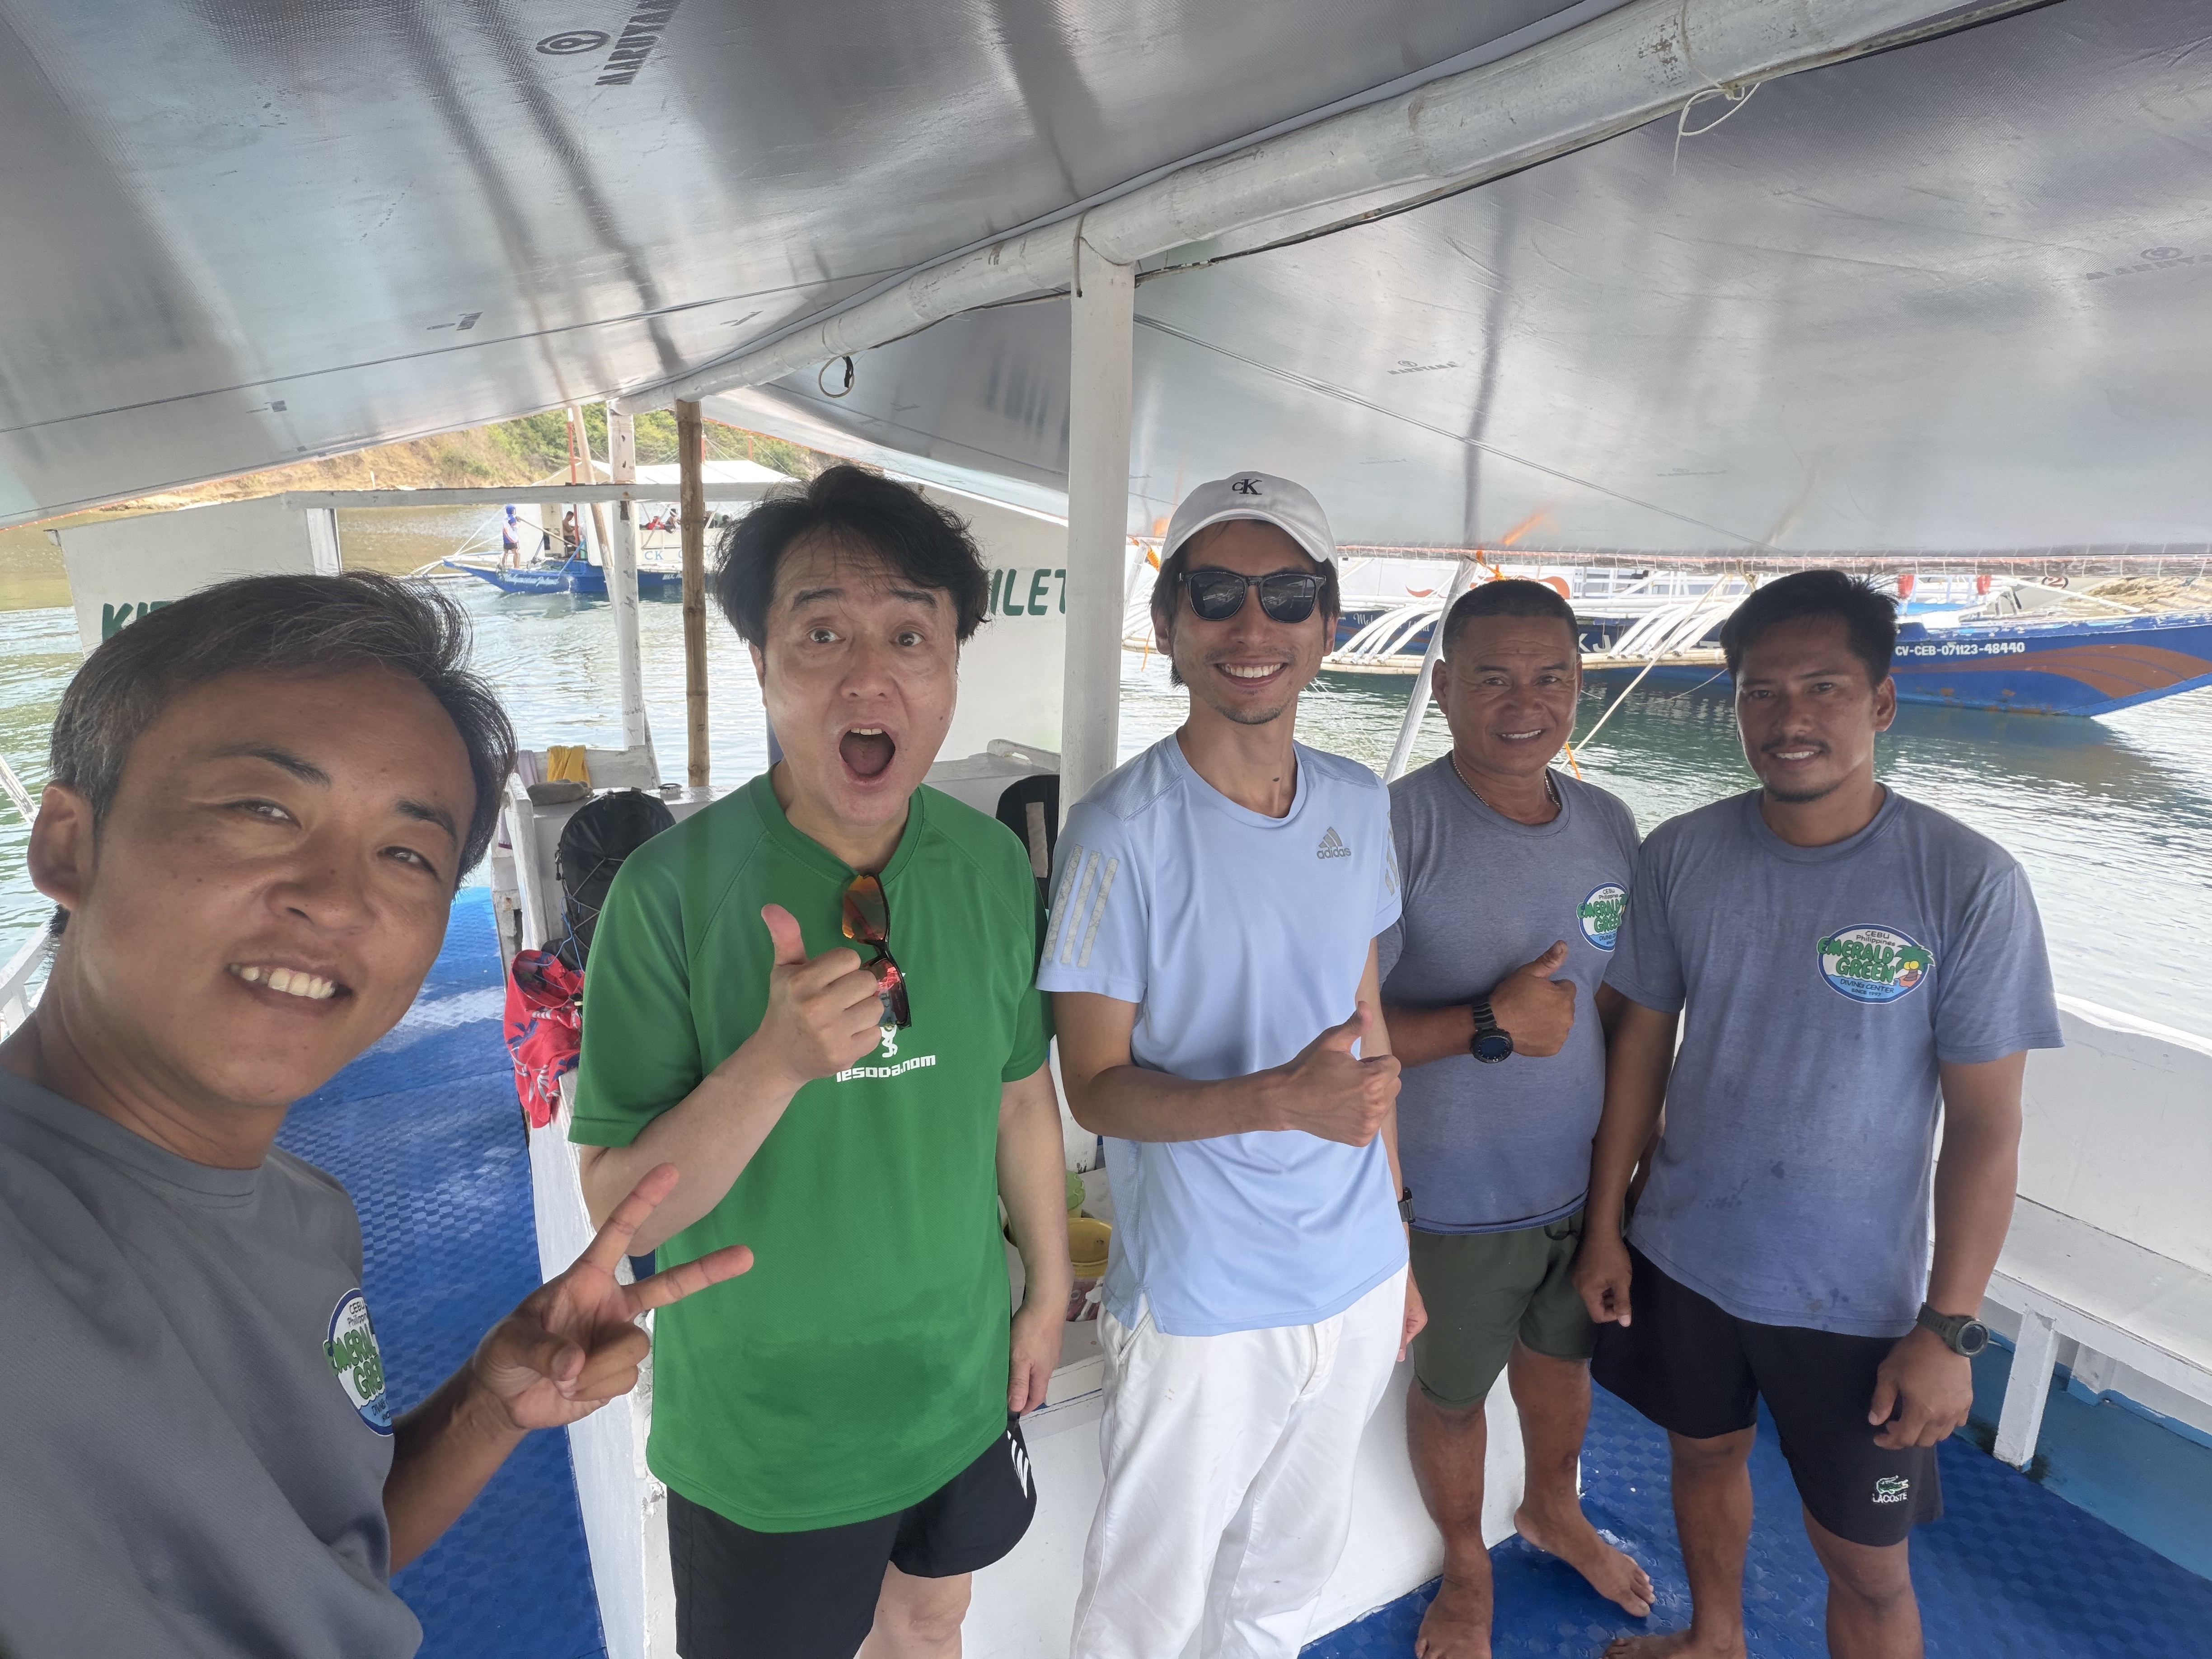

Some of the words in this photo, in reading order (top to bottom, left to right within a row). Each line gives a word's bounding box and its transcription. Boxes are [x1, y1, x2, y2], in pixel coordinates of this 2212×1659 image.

[1895, 642, 2025, 656] CV-CEB-071123-48440
[1317, 846, 1351, 859] adidas
[1856, 935, 1895, 947] Philippines
[1865, 930, 1890, 939] CEBU
[1818, 937, 1894, 964] EMERALD
[1836, 957, 1894, 983] GREEN
[1840, 979, 1864, 988] DIVING
[1866, 984, 1894, 994] CENTER
[1872, 1492, 1907, 1503] LACOSTE
